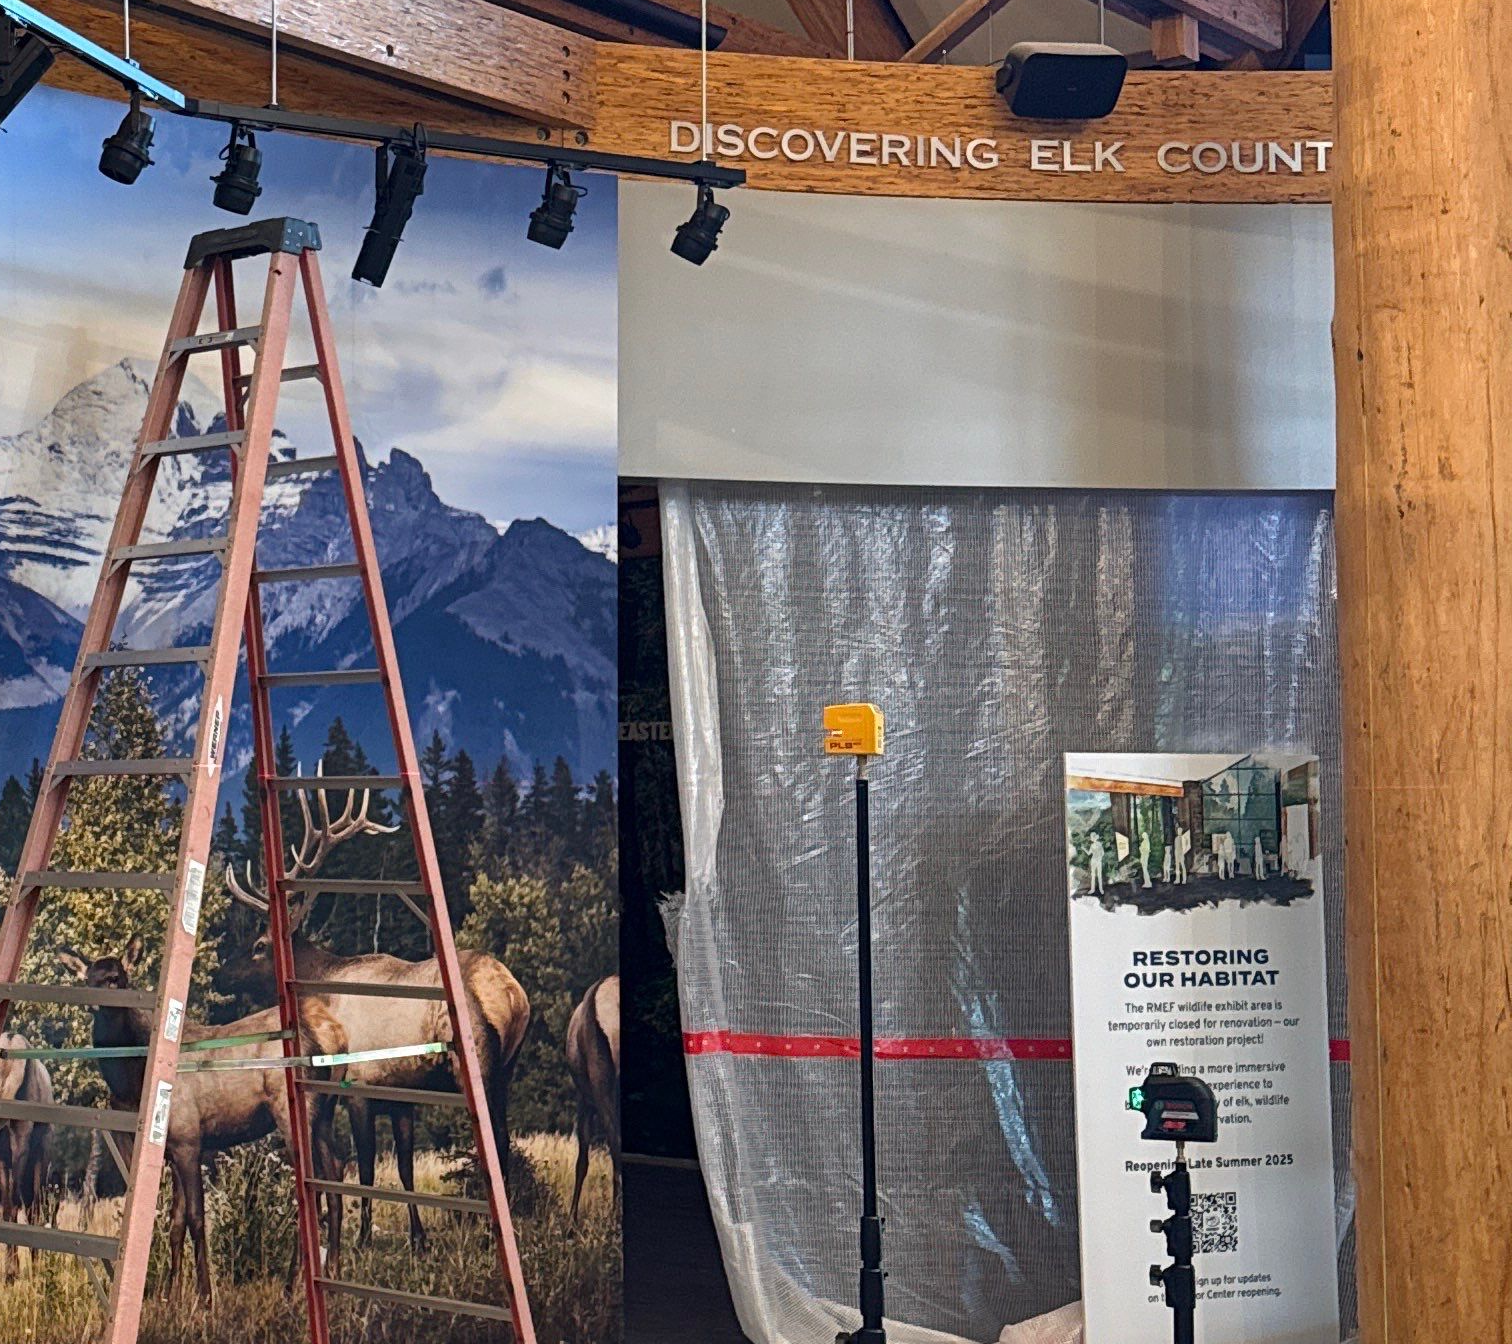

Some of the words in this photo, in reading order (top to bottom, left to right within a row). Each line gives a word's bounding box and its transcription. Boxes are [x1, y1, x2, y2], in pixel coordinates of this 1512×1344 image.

[669, 120, 1000, 170] DISCOVERING
[1030, 139, 1126, 172] ELK
[1133, 948, 1270, 966] RESTORING
[1123, 971, 1175, 988] OUR
[1181, 970, 1280, 987] HABITAT
[1124, 1002, 1145, 1014] The
[1146, 1002, 1176, 1013] RMEF
[1177, 1000, 1213, 1012] wildlife
[1214, 1000, 1249, 1012] exhibit
[1250, 1001, 1273, 1011] area
[1274, 999, 1283, 1010] is
[1107, 1019, 1167, 1032] temporarily
[1168, 1018, 1201, 1030] closed
[1202, 1018, 1217, 1030] for
[1219, 1017, 1273, 1029] renovation
[1283, 1017, 1300, 1027] our
[1146, 1037, 1168, 1048] own
[1169, 1034, 1225, 1047] restoration
[1226, 1033, 1265, 1047] project!
[1198, 1066, 1205, 1074] a
[1206, 1064, 1234, 1074] more
[1235, 1061, 1286, 1073] immersive
[1262, 1079, 1273, 1090] to
[1223, 1097, 1234, 1107] of
[1235, 1095, 1253, 1108] elk,
[1255, 1094, 1290, 1106] wildlife
[1188, 1157, 1213, 1169] Late
[1215, 1155, 1263, 1169] Summer
[1265, 1153, 1294, 1166] 2025
[1211, 1275, 1222, 1286] up
[1223, 1273, 1237, 1284] for
[1238, 1272, 1272, 1285] updates
[1148, 1294, 1159, 1304] on
[1207, 1288, 1236, 1299] Center
[1237, 1285, 1282, 1299] reopening.
